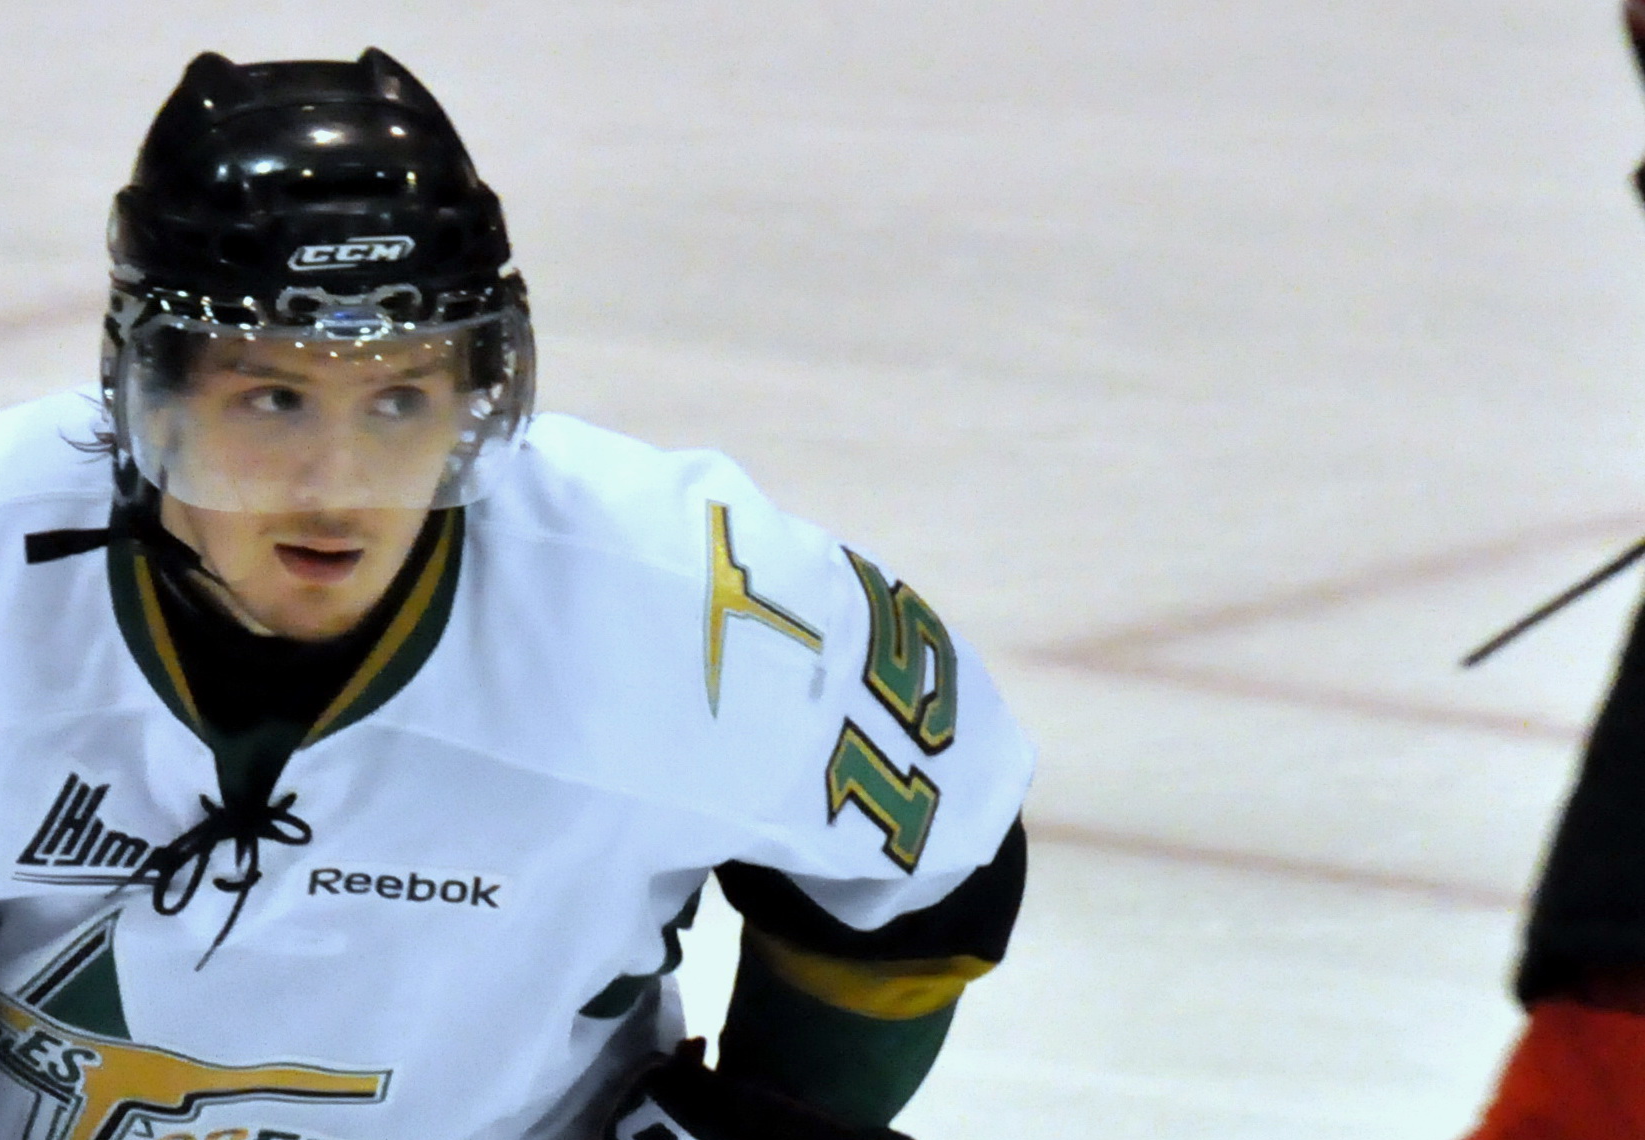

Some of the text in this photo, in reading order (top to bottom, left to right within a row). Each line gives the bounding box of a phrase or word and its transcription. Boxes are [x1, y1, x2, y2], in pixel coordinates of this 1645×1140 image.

[300, 243, 403, 263] CCM
[826, 545, 959, 876] 15
[308, 867, 501, 909] Reebok
